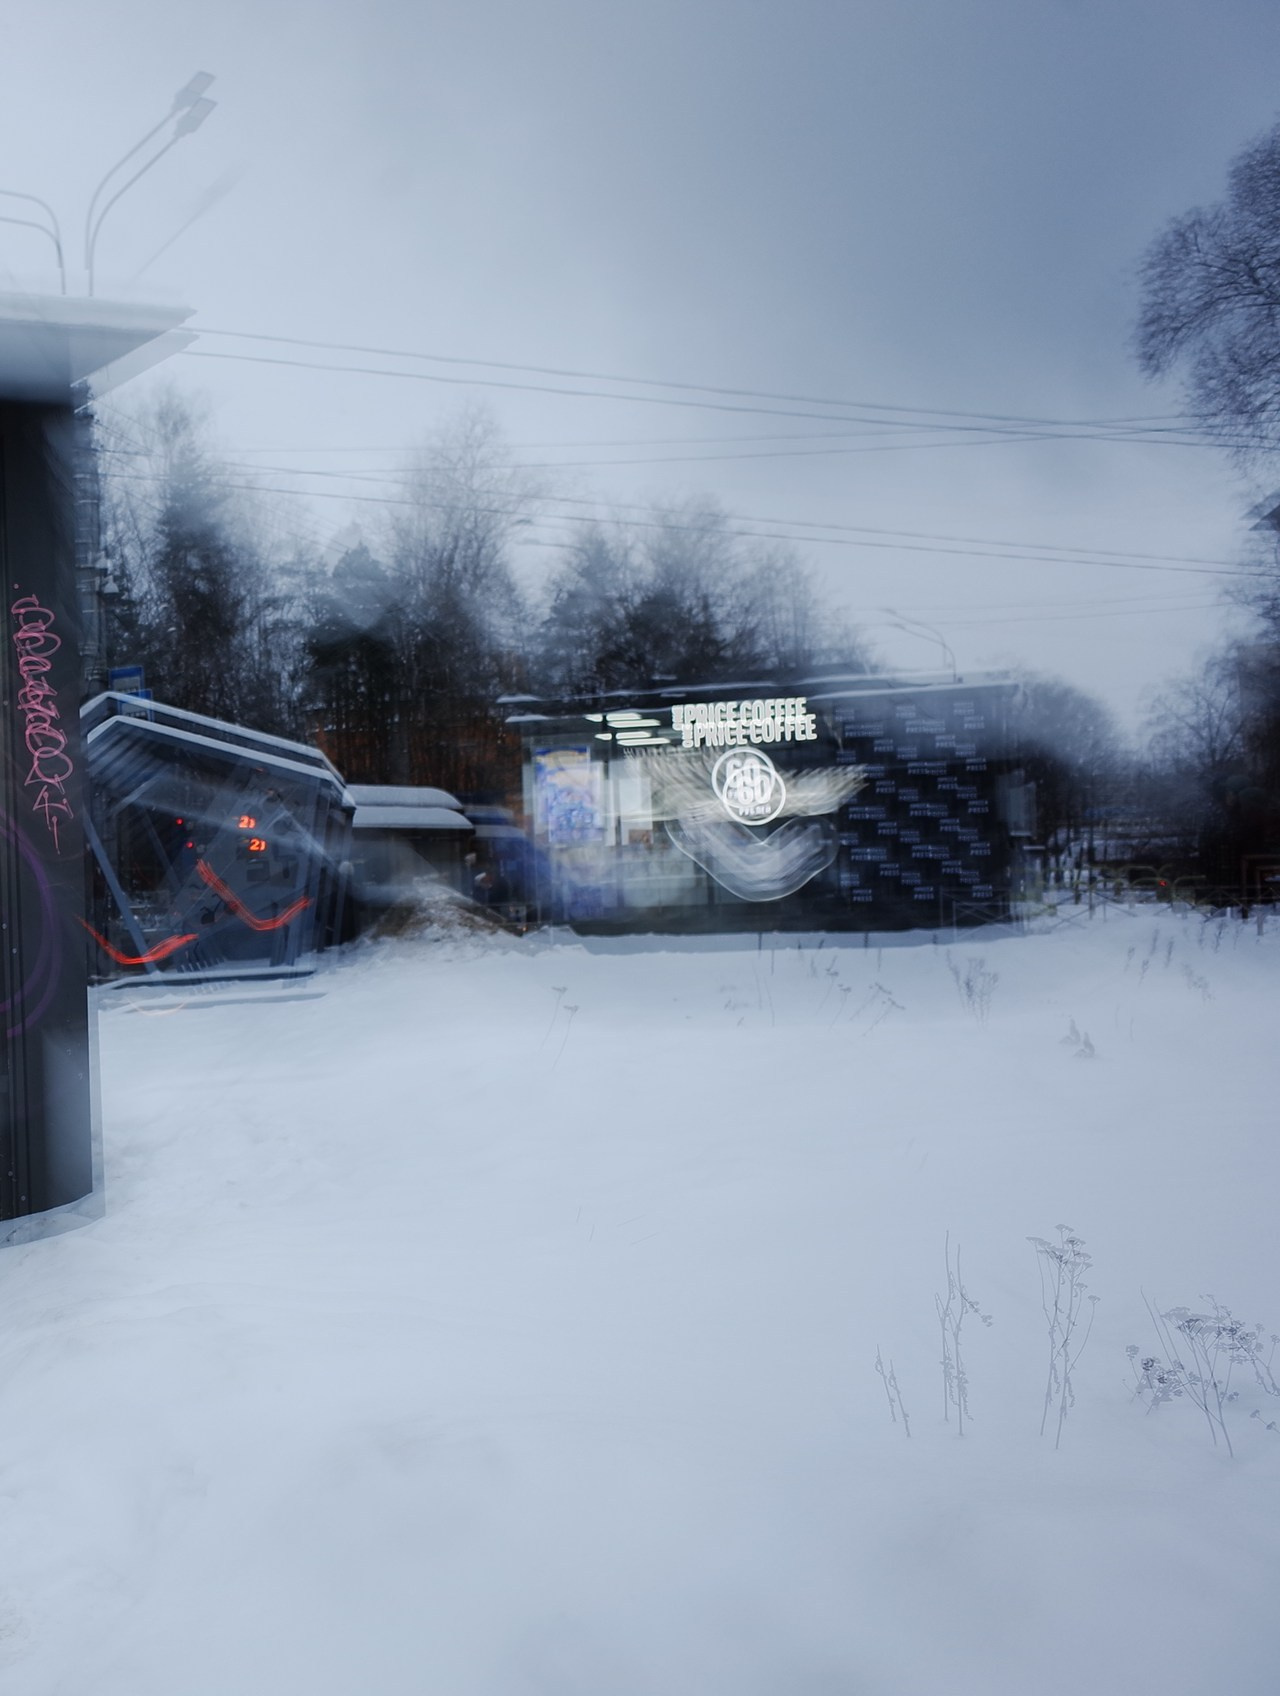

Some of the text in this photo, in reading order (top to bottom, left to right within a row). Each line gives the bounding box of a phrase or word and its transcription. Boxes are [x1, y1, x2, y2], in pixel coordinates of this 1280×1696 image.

[684, 701, 738, 729] PRICE
[739, 696, 808, 726] COFFEE
[694, 719, 749, 748] PRICE
[749, 713, 818, 744] COFFEE
[737, 774, 772, 806] 60
